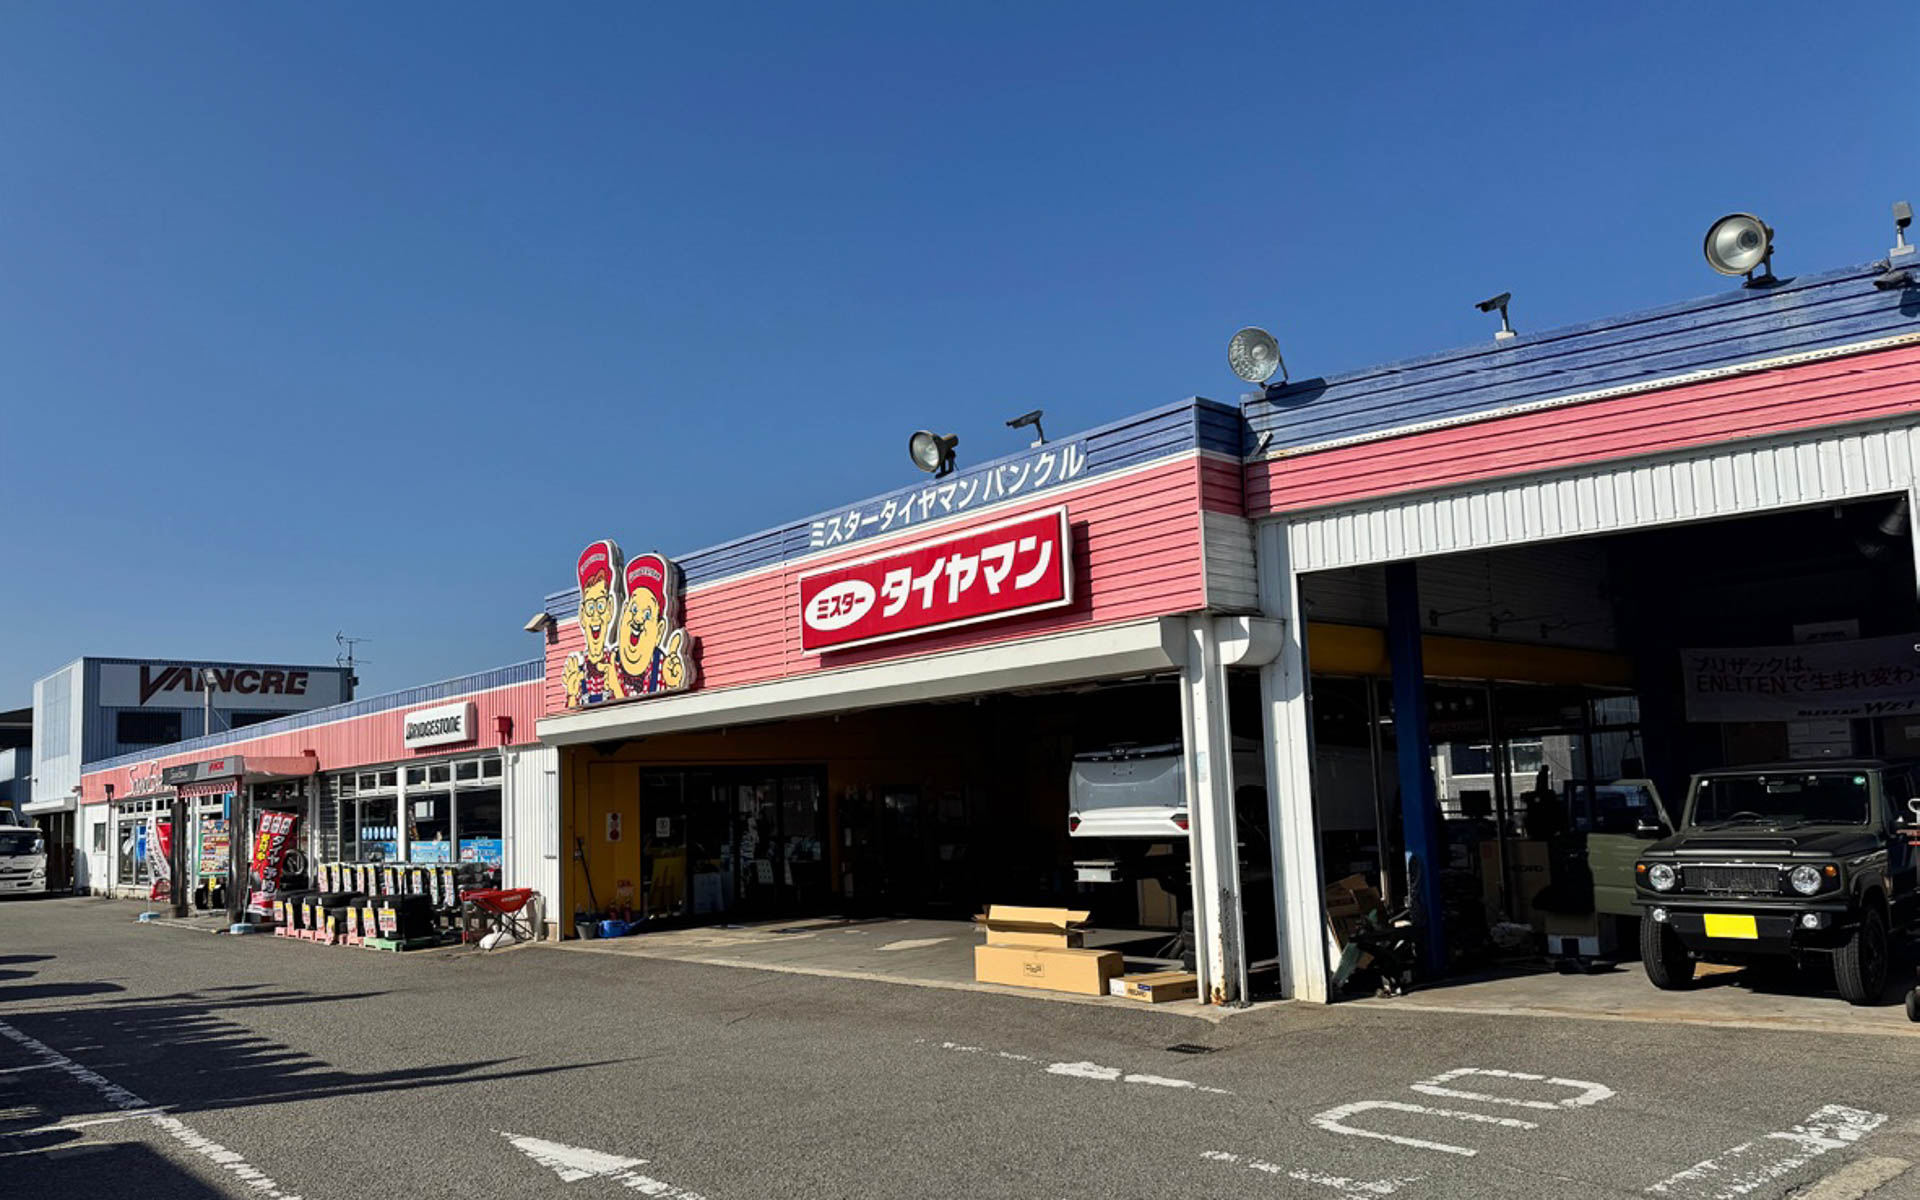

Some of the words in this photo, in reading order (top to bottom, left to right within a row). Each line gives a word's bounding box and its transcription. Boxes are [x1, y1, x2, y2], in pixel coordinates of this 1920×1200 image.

[816, 592, 866, 620] ミスター
[881, 536, 1053, 618] タイヤマン
[1696, 666, 1920, 694] ENLITENで生まれ変わ
[406, 715, 462, 740] BRIDGESTONE
